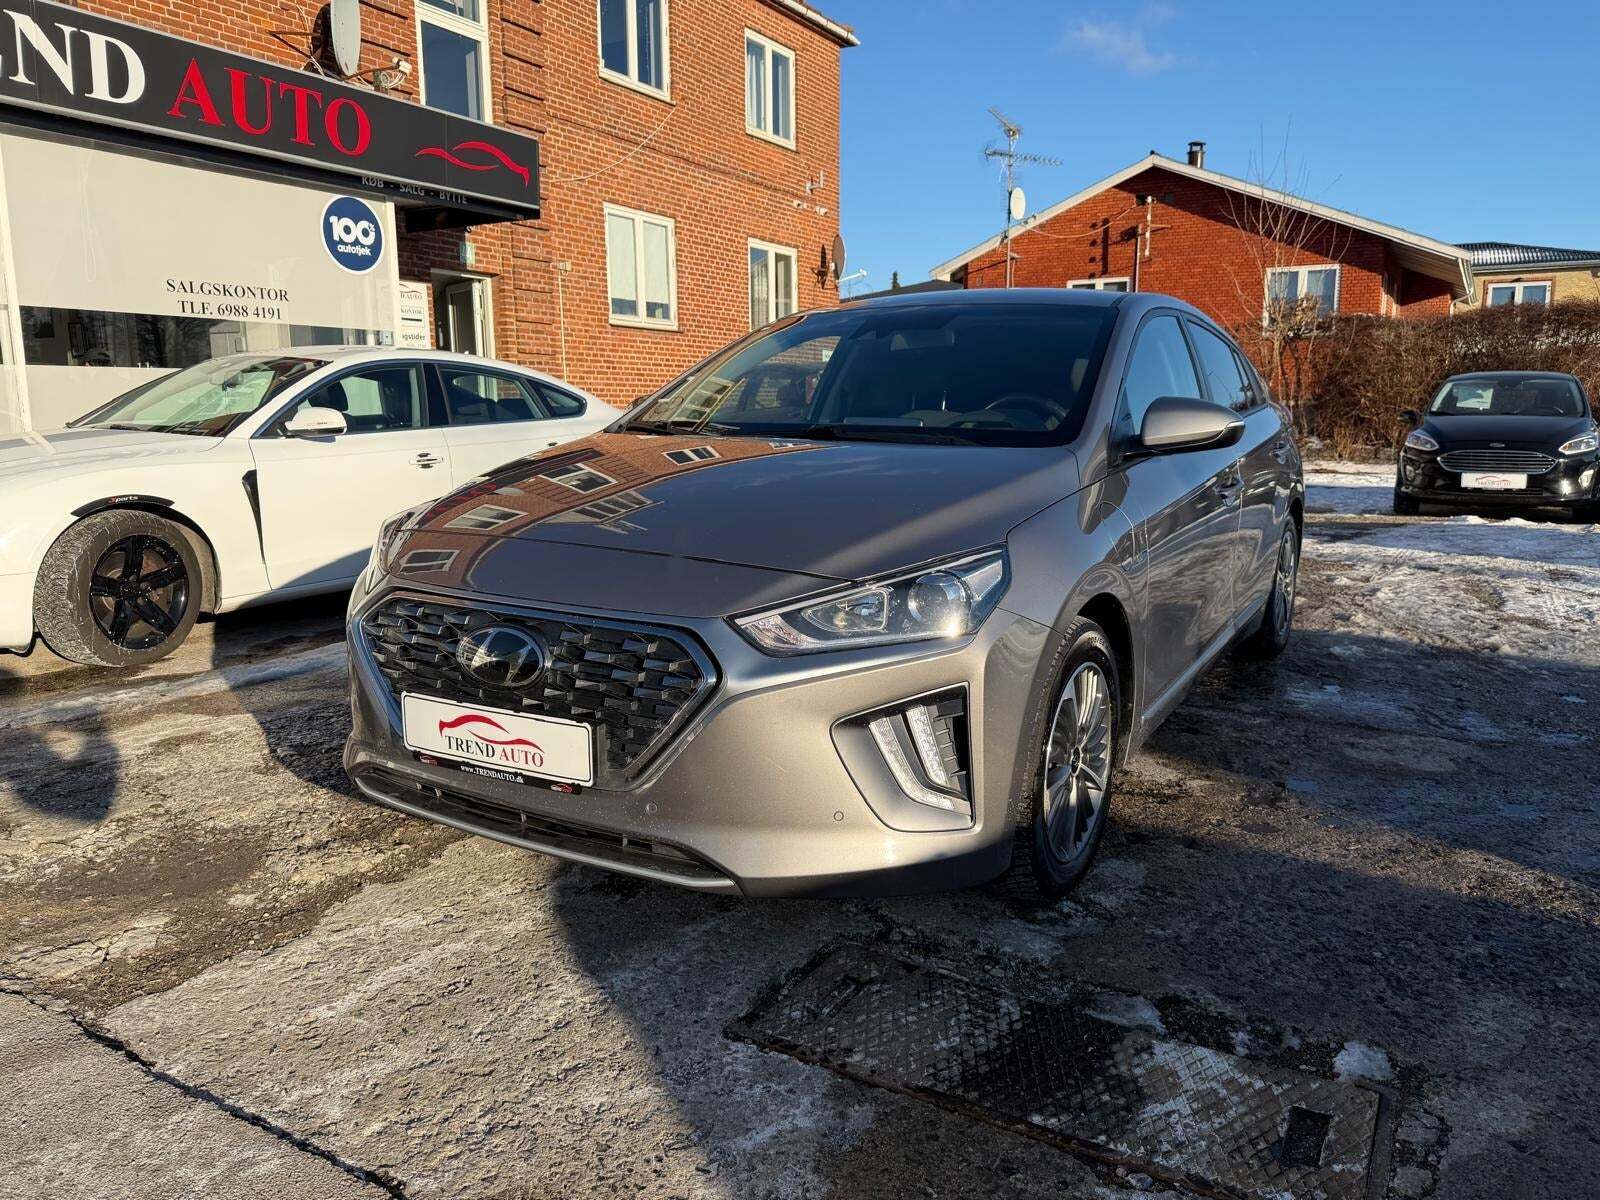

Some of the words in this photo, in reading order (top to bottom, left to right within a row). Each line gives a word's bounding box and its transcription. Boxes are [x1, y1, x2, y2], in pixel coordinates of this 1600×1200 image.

[0, 9, 145, 104] ND
[166, 57, 372, 159] AUTO
[400, 183, 425, 196] SALG
[337, 244, 372, 257] autotjek
[166, 278, 289, 302] SALGSKONTOR
[177, 300, 213, 316] TLF.
[217, 303, 249, 318] 6988
[252, 305, 281, 320] 4191
[445, 735, 496, 759] TREND
[499, 748, 545, 768] AUTO
